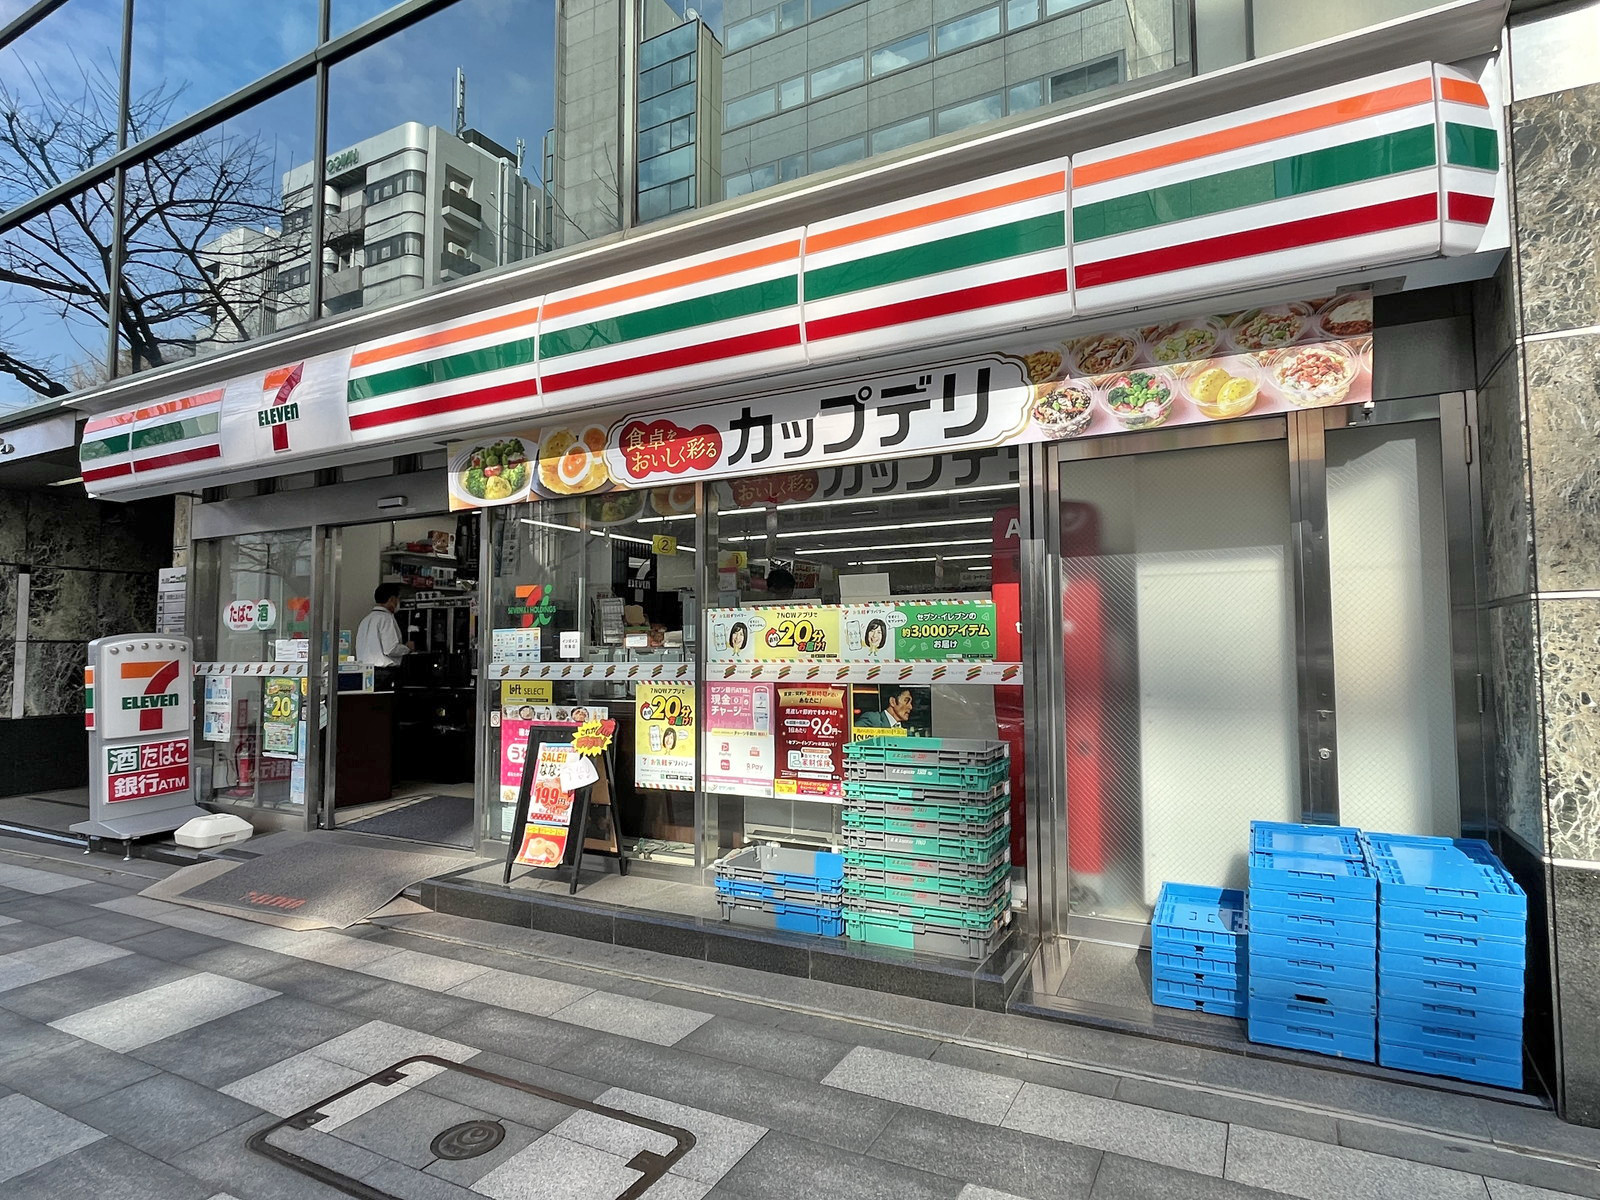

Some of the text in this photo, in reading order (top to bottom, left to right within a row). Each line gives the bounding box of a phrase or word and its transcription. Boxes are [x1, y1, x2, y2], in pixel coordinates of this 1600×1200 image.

[728, 368, 990, 466] カップデリ
[626, 427, 677, 452] 食卓を
[632, 437, 717, 472] おいしく彩る
[230, 604, 253, 622] たばこ
[258, 604, 268, 621] 酒
[902, 624, 990, 637] 約3,000アイテム
[933, 640, 958, 648] お届け
[121, 660, 179, 731] 7
[711, 694, 730, 705] 現金
[711, 706, 741, 716] チャージ
[110, 748, 138, 773] 酒
[142, 742, 187, 768] たばこ
[541, 752, 567, 763] SALE!!
[114, 773, 186, 798] 銀行ATM
